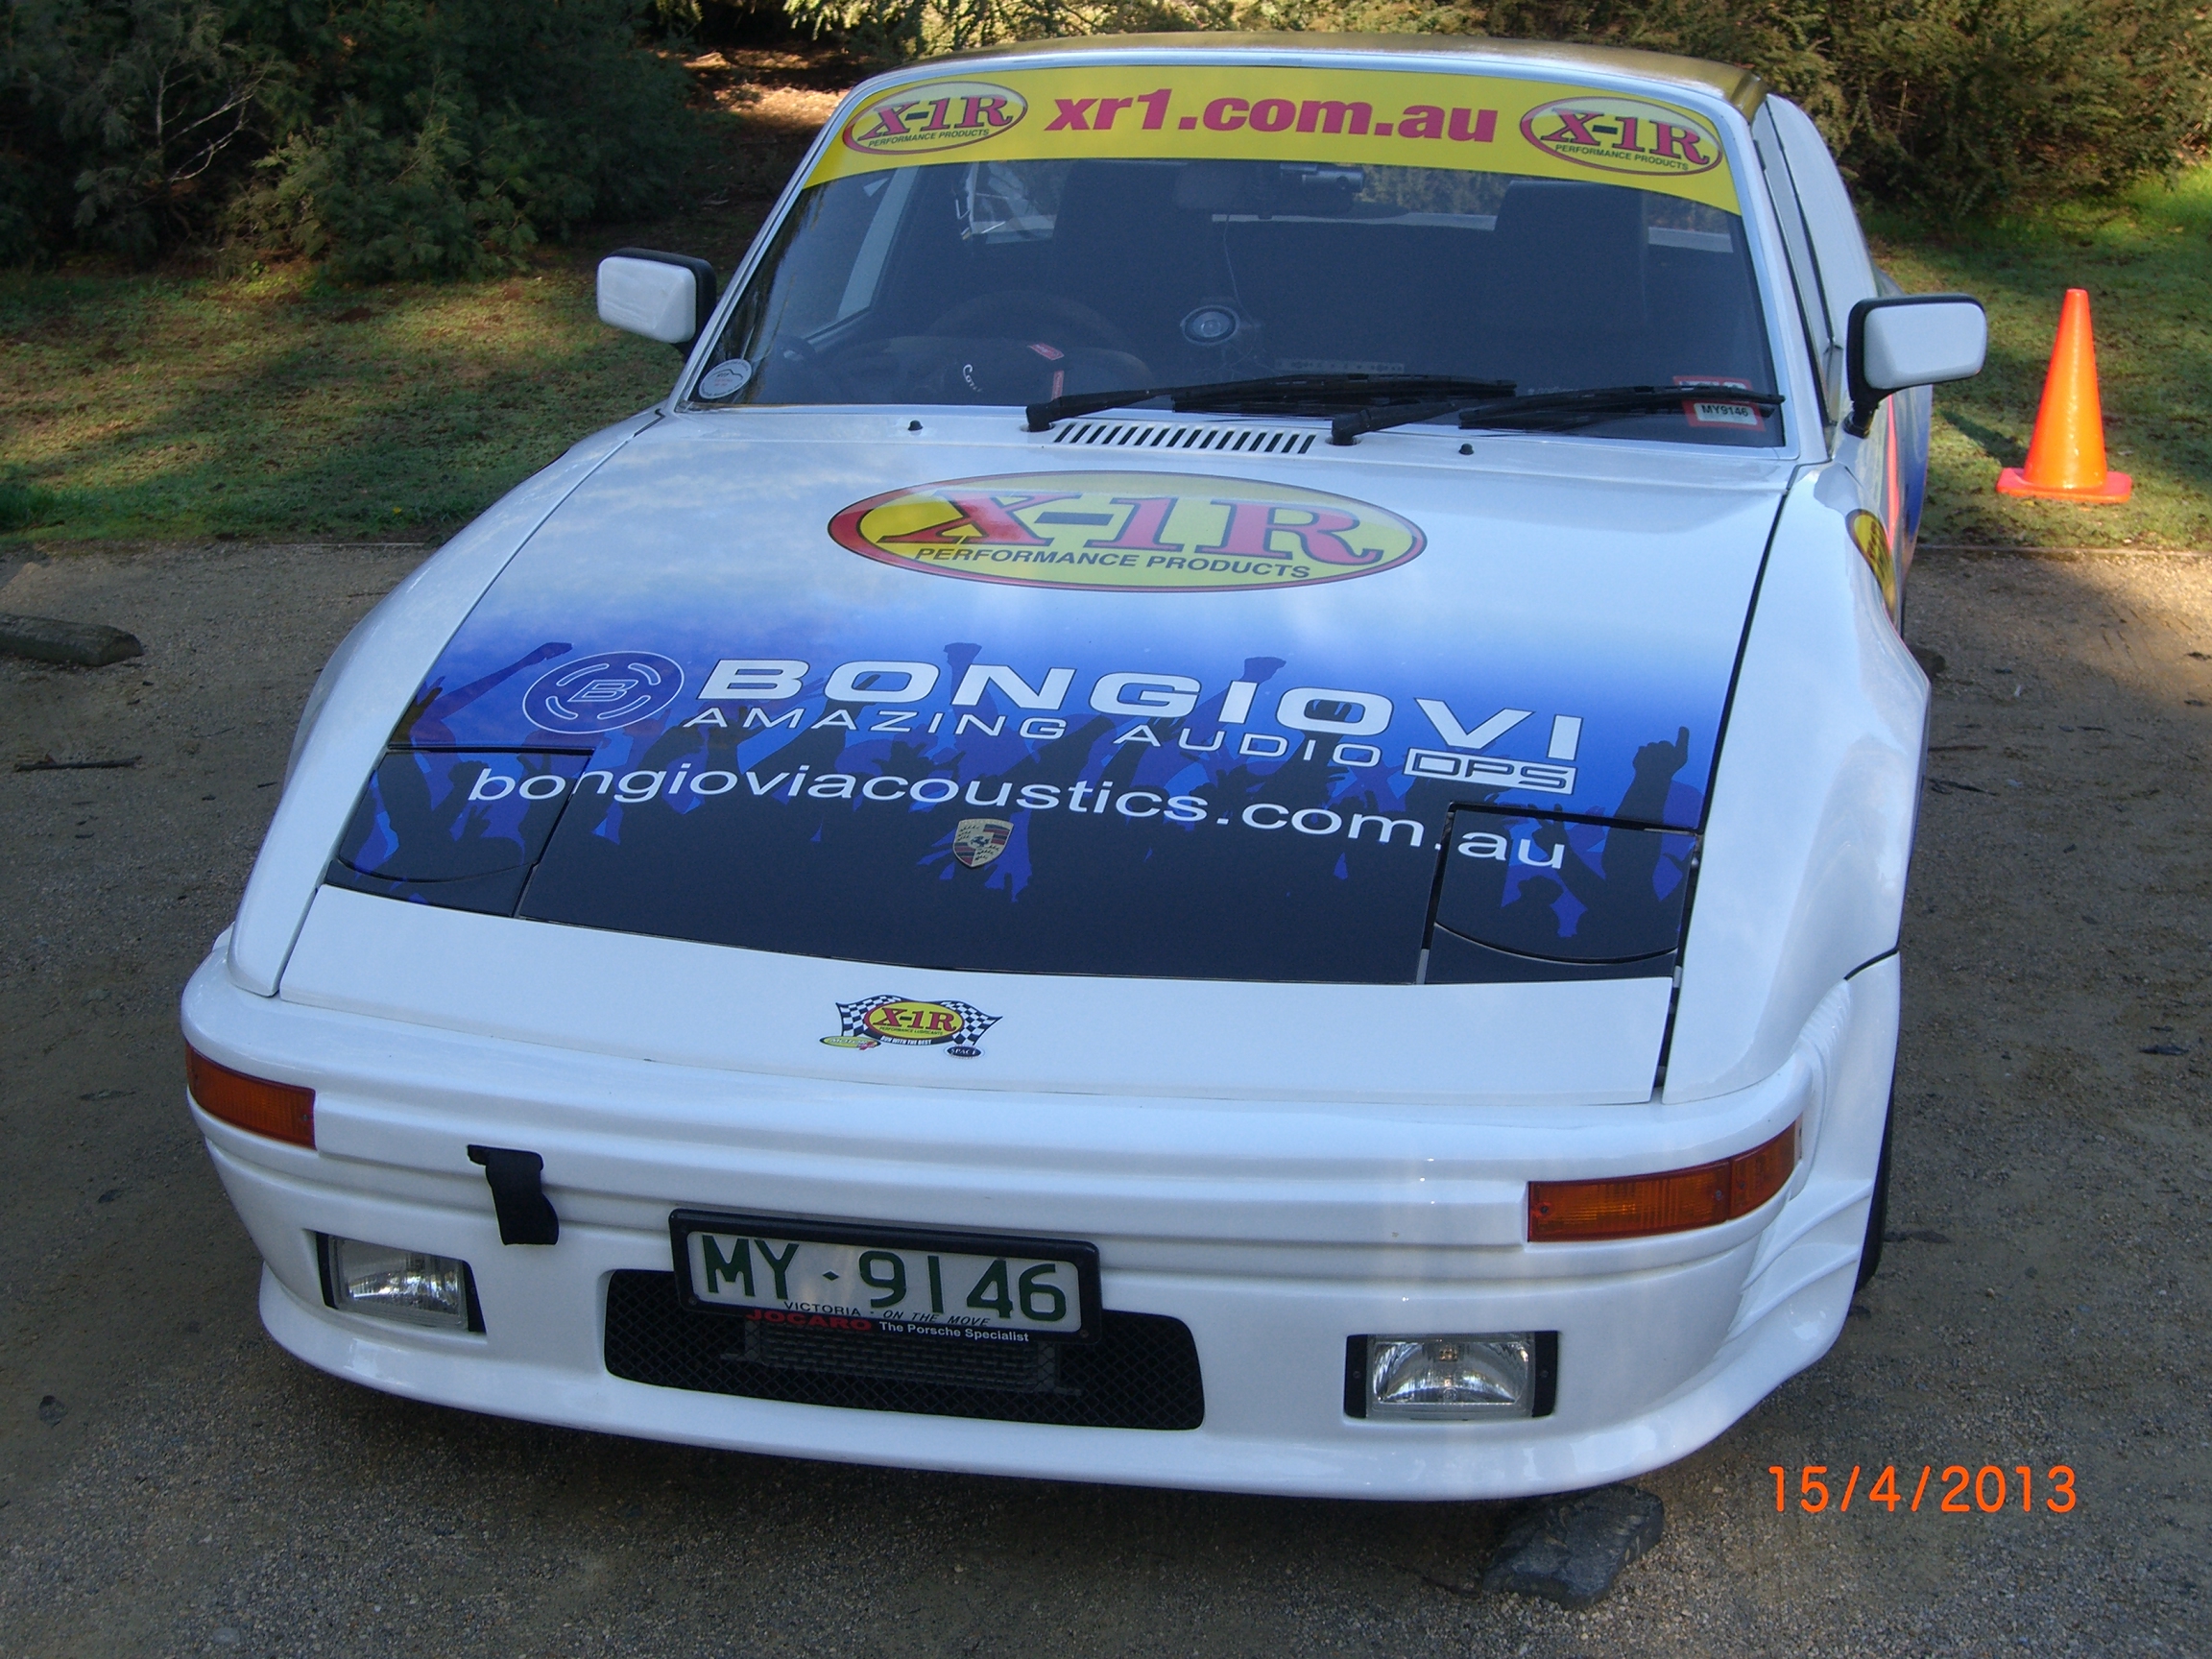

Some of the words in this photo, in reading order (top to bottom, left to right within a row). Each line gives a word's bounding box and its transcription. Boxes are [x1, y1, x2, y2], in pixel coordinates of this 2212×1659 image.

[857, 94, 1013, 141] X-1R
[1044, 88, 1498, 143] xr1.com.au
[868, 132, 936, 147] PERFORMANCE
[938, 129, 989, 139] PRODUCTS
[1540, 108, 1710, 165] X-1R
[1555, 144, 1632, 160] PERFORMANCE
[1634, 154, 1689, 171] PRODUCTS
[1701, 405, 1749, 417] MY9146
[876, 489, 1384, 566] X-1R
[915, 547, 1138, 567] PERFORMANCE
[1146, 557, 1311, 578] PRODUCTS
[697, 659, 1584, 761] BONGIOVI
[683, 707, 1067, 739] AMAZING
[1114, 724, 1382, 768] AUDIO
[468, 762, 1565, 870] bongioviacoustics.com.au
[873, 1008, 957, 1031] X-1R
[746, 1309, 872, 1331] JOCARO
[879, 1321, 904, 1333] The
[907, 1324, 961, 1337] Porsche
[965, 1328, 1029, 1342] Specialist
[784, 1301, 861, 1316] VICTORIA
[882, 1310, 904, 1320] ON
[912, 1312, 939, 1324] THE
[948, 1315, 991, 1327] MOVE
